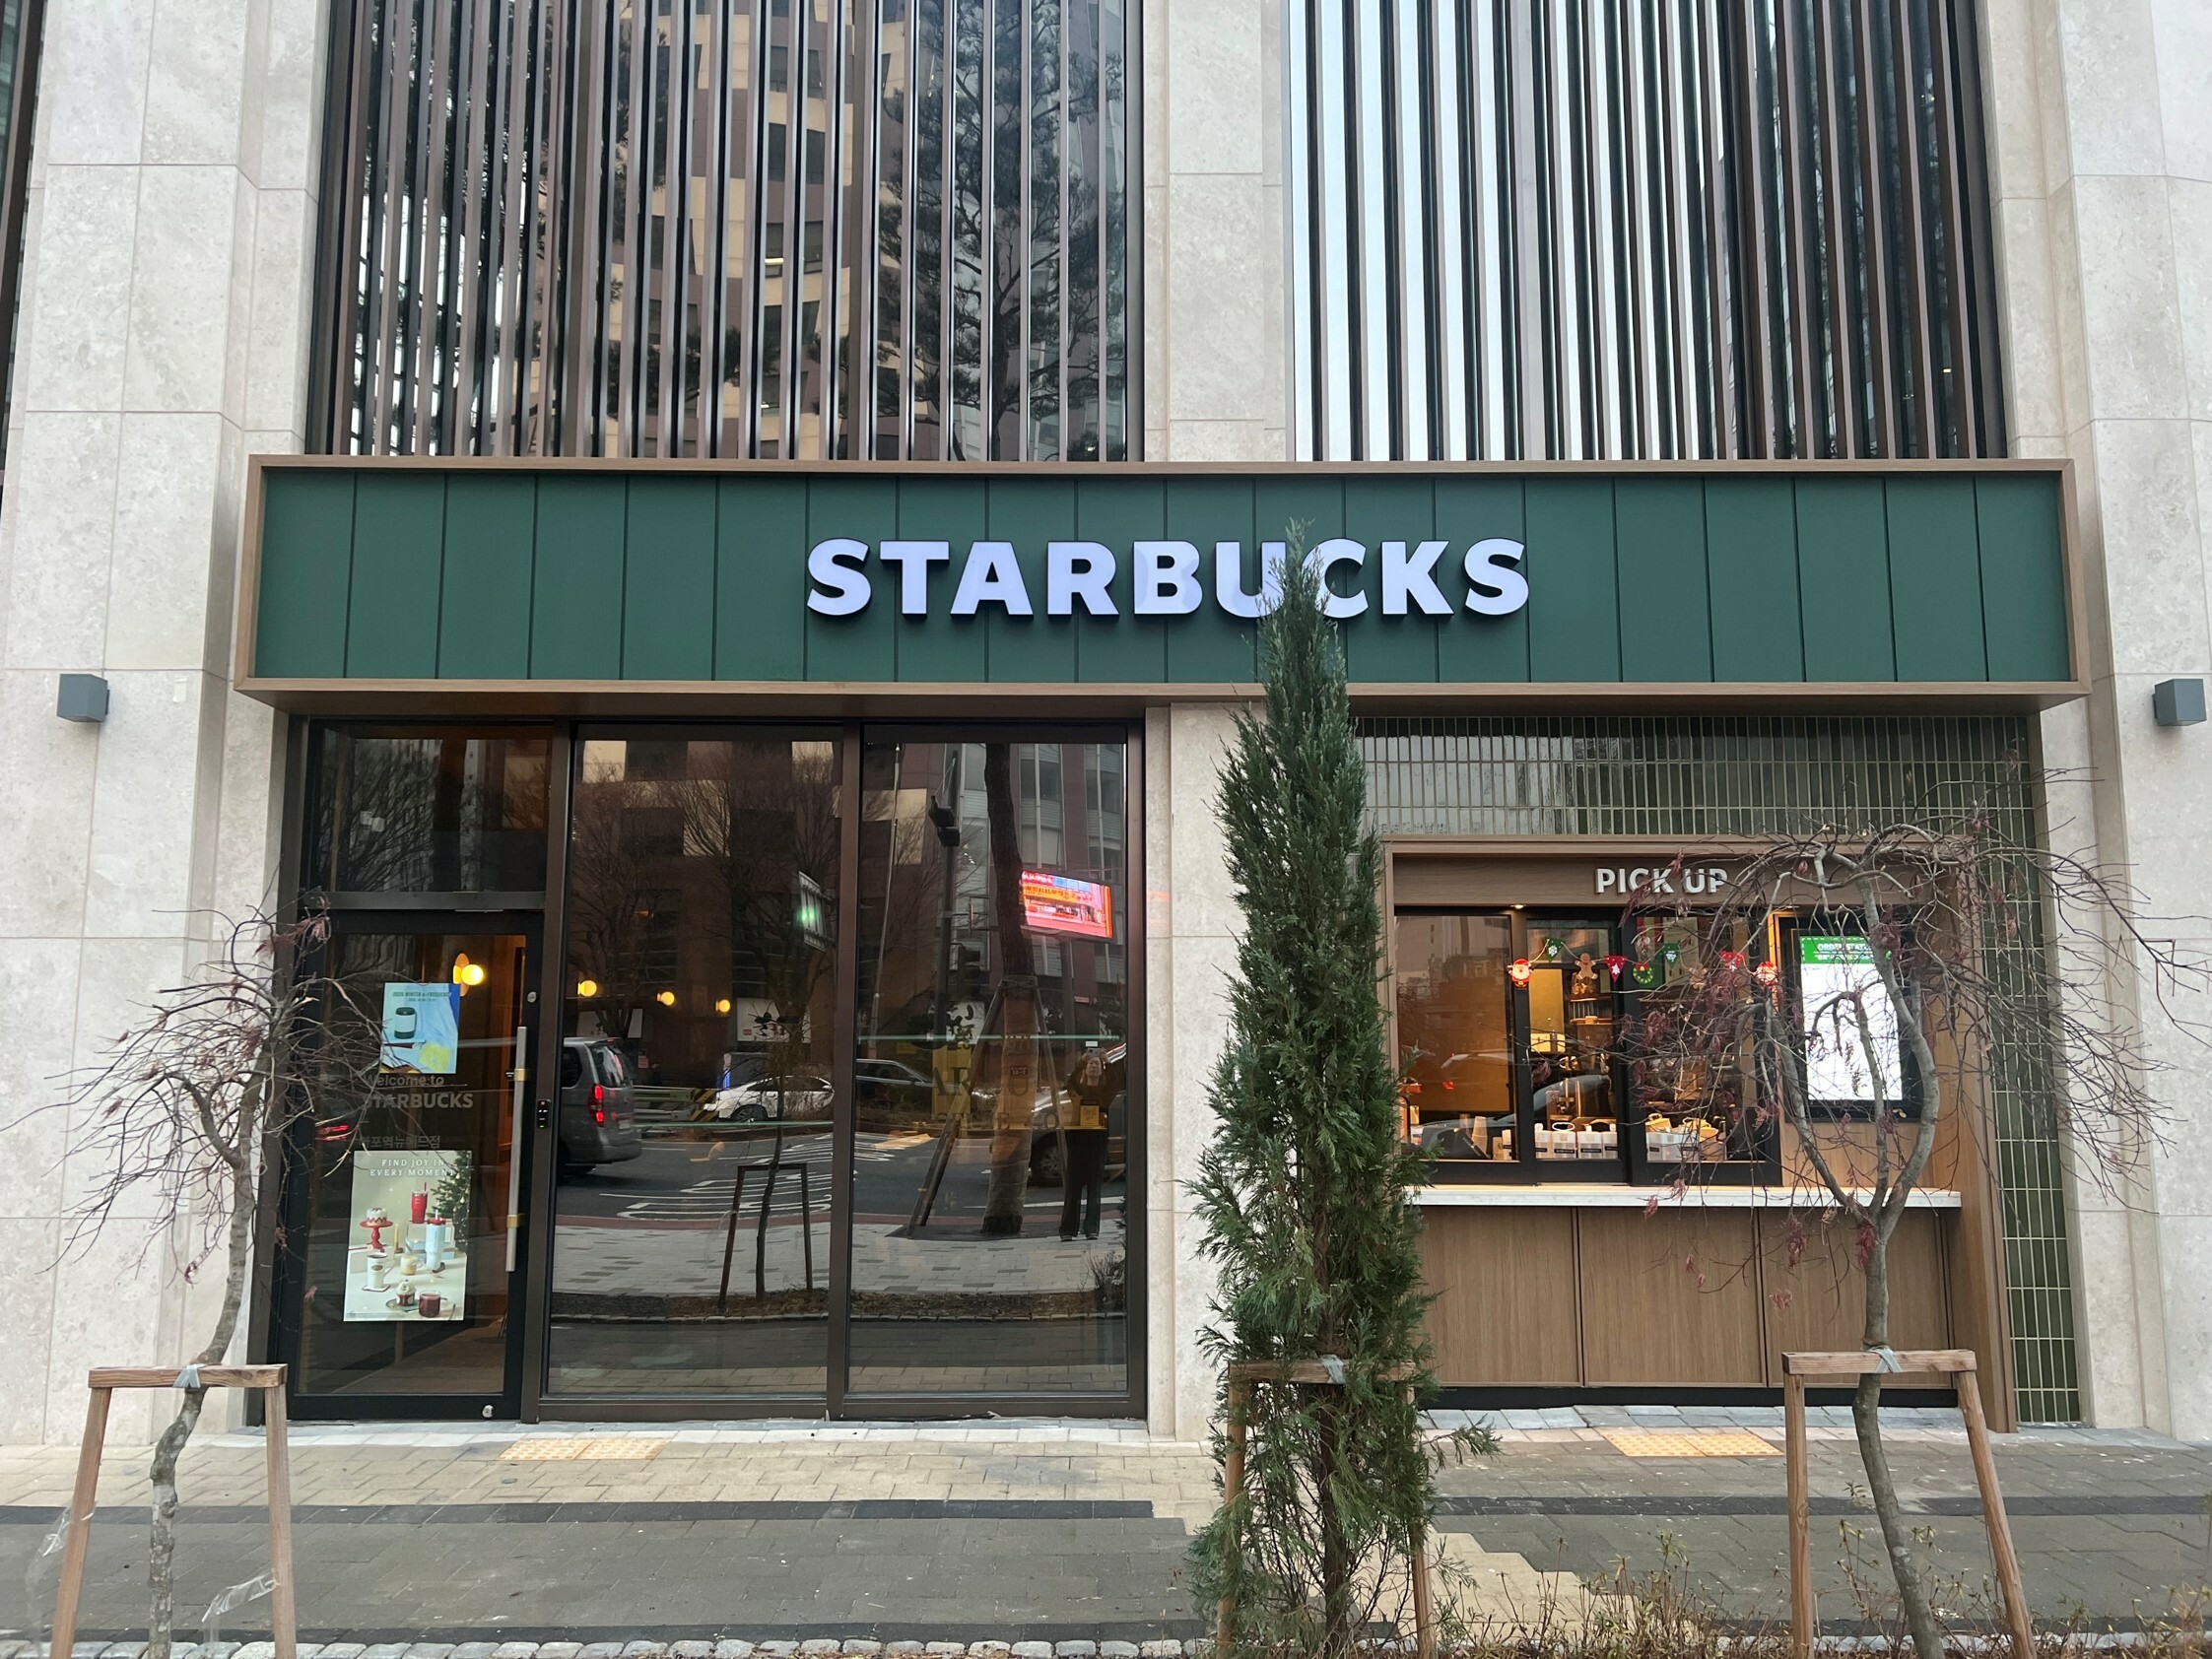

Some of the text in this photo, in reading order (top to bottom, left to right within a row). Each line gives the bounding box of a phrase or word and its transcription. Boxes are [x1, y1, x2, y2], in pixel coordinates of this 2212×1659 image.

[806, 537, 1530, 619] STARBUCKS
[1595, 868, 1728, 894] PICK UP
[363, 1075, 445, 1086] Welcome to
[411, 1159, 429, 1167] JOY
